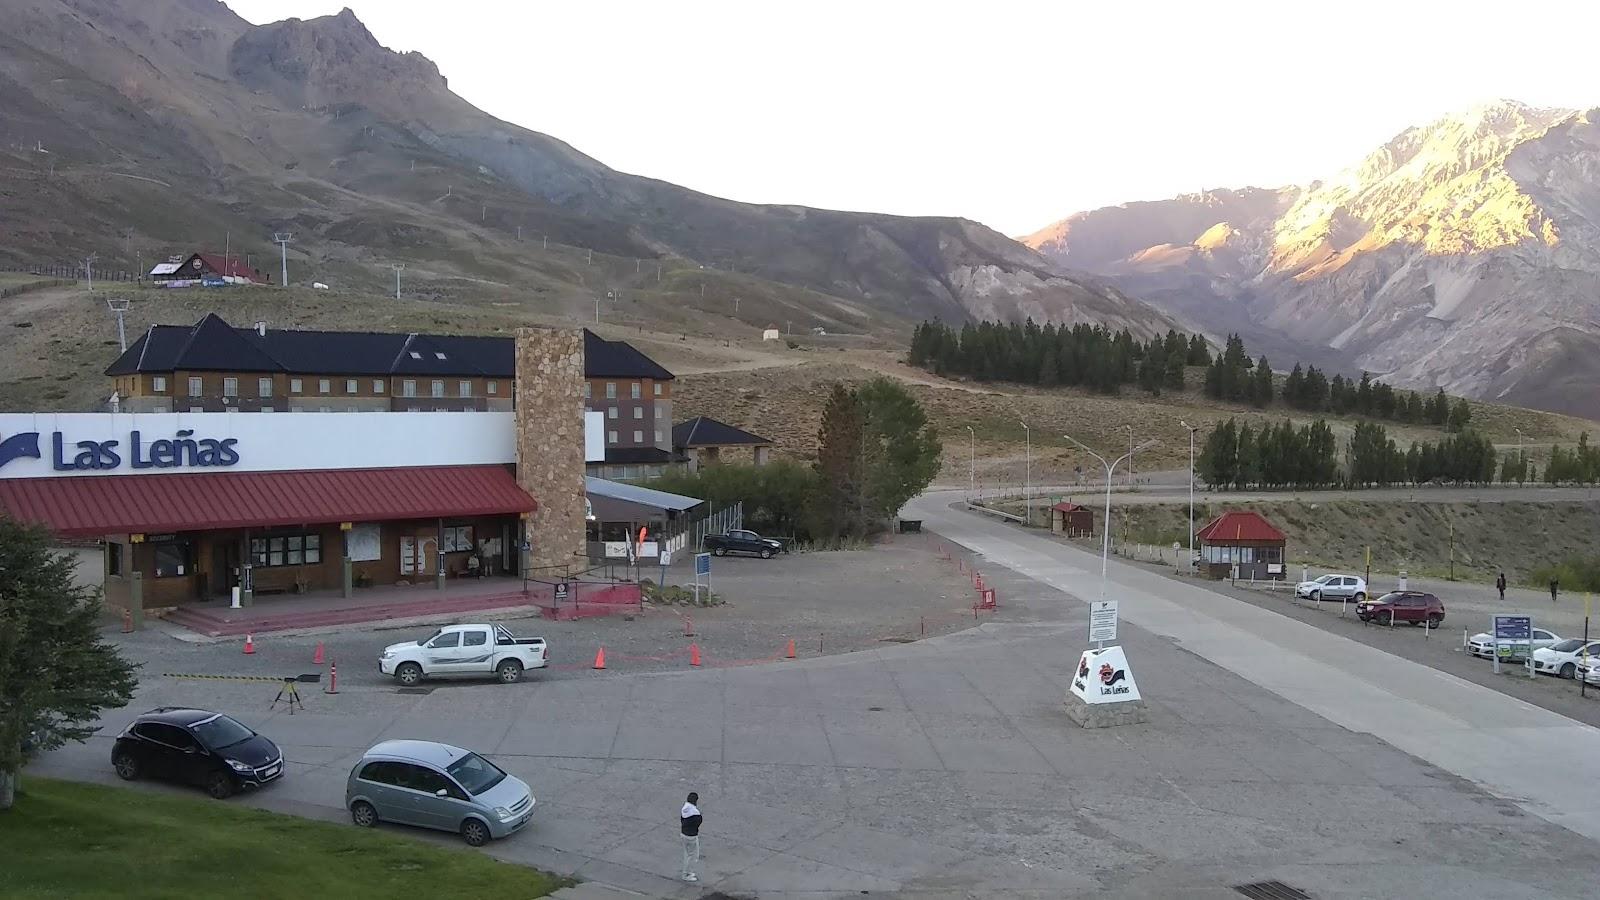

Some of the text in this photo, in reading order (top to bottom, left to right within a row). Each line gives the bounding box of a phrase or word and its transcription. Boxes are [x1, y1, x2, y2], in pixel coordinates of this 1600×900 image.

[52, 429, 240, 471] Las Leñas
[1100, 685, 1130, 695] Las Leñas
